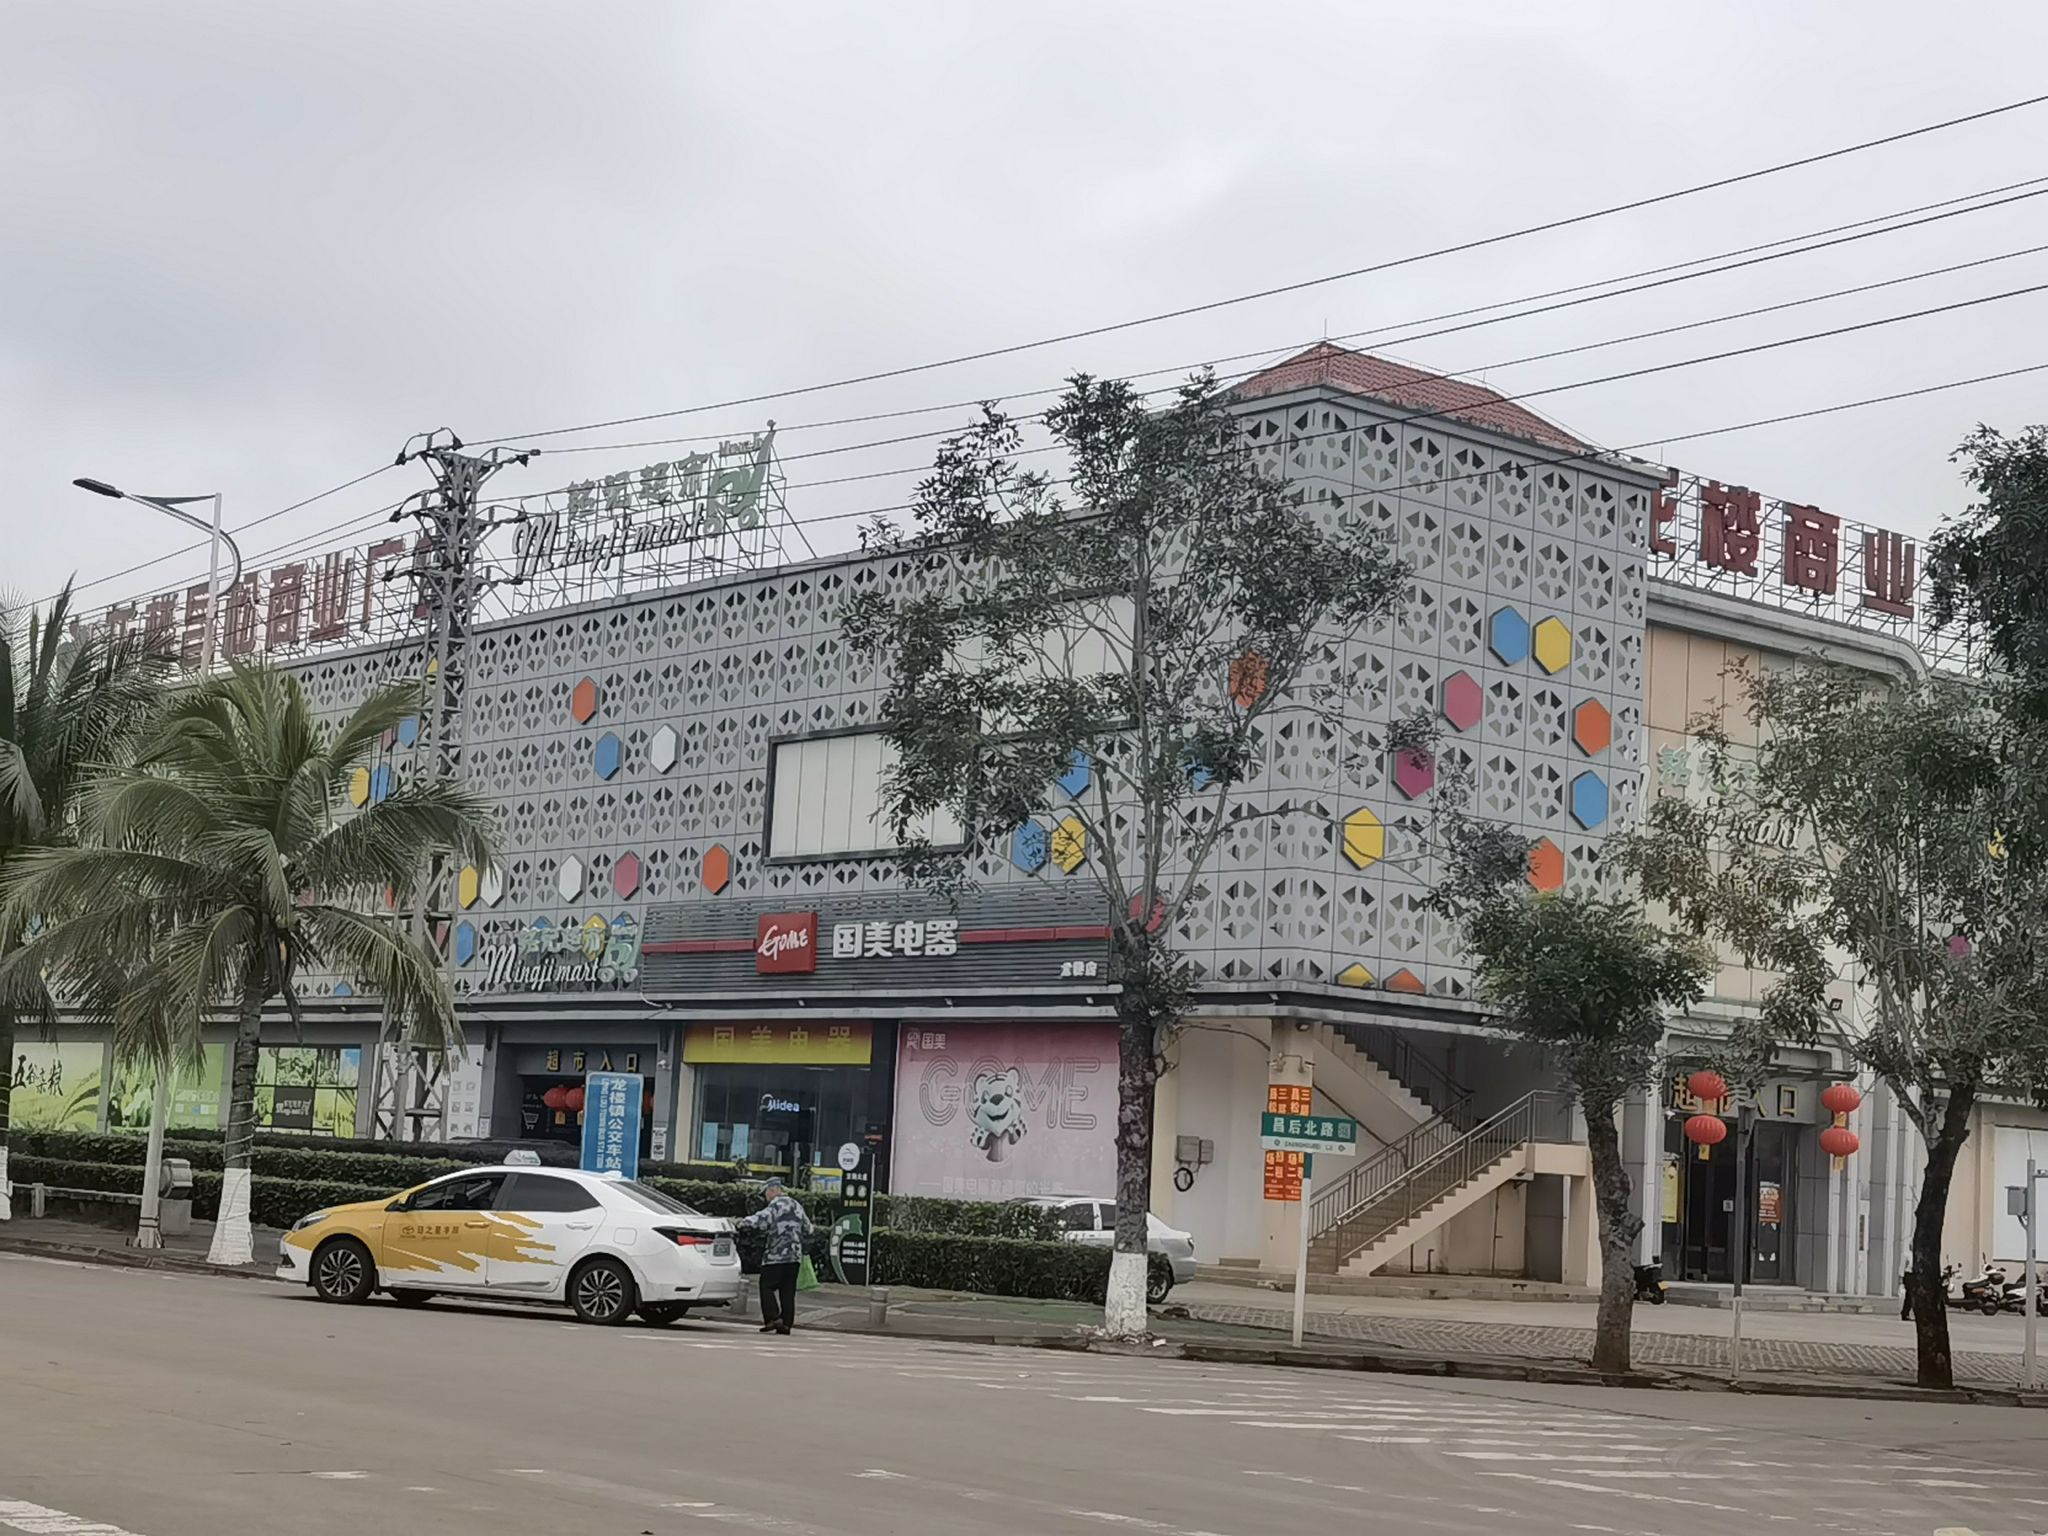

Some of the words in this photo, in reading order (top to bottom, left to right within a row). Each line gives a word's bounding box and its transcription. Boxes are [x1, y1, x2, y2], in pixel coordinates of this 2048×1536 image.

[832, 920, 959, 958] 国美电器
[546, 1049, 638, 1073] 超市入口
[1672, 1072, 1798, 1118] 超入口
